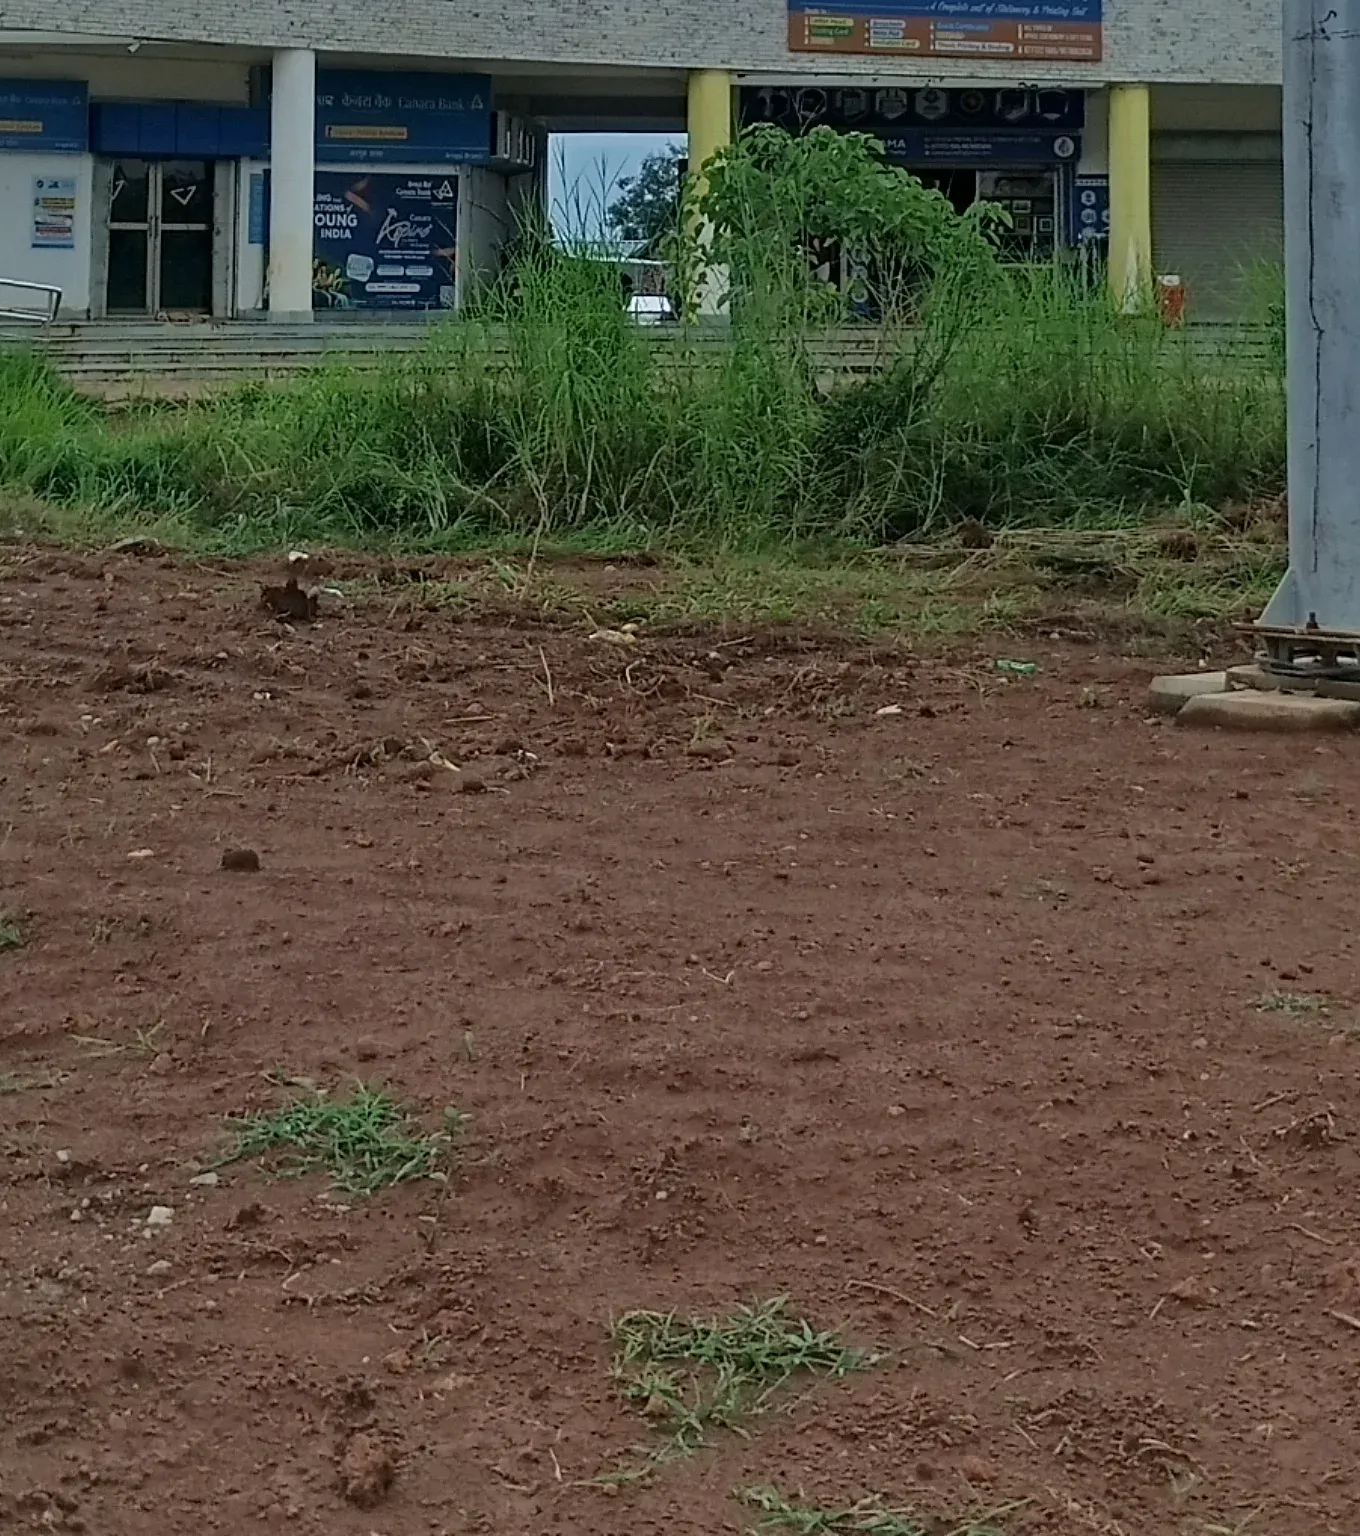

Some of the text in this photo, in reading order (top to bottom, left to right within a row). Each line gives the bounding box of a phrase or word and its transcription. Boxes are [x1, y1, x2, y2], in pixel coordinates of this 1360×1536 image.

[397, 96, 466, 110] Canara Bank
[315, 193, 331, 202] ING
[314, 204, 345, 212] ATIONS
[314, 213, 358, 227] OUNG
[320, 228, 352, 239] INDIA
